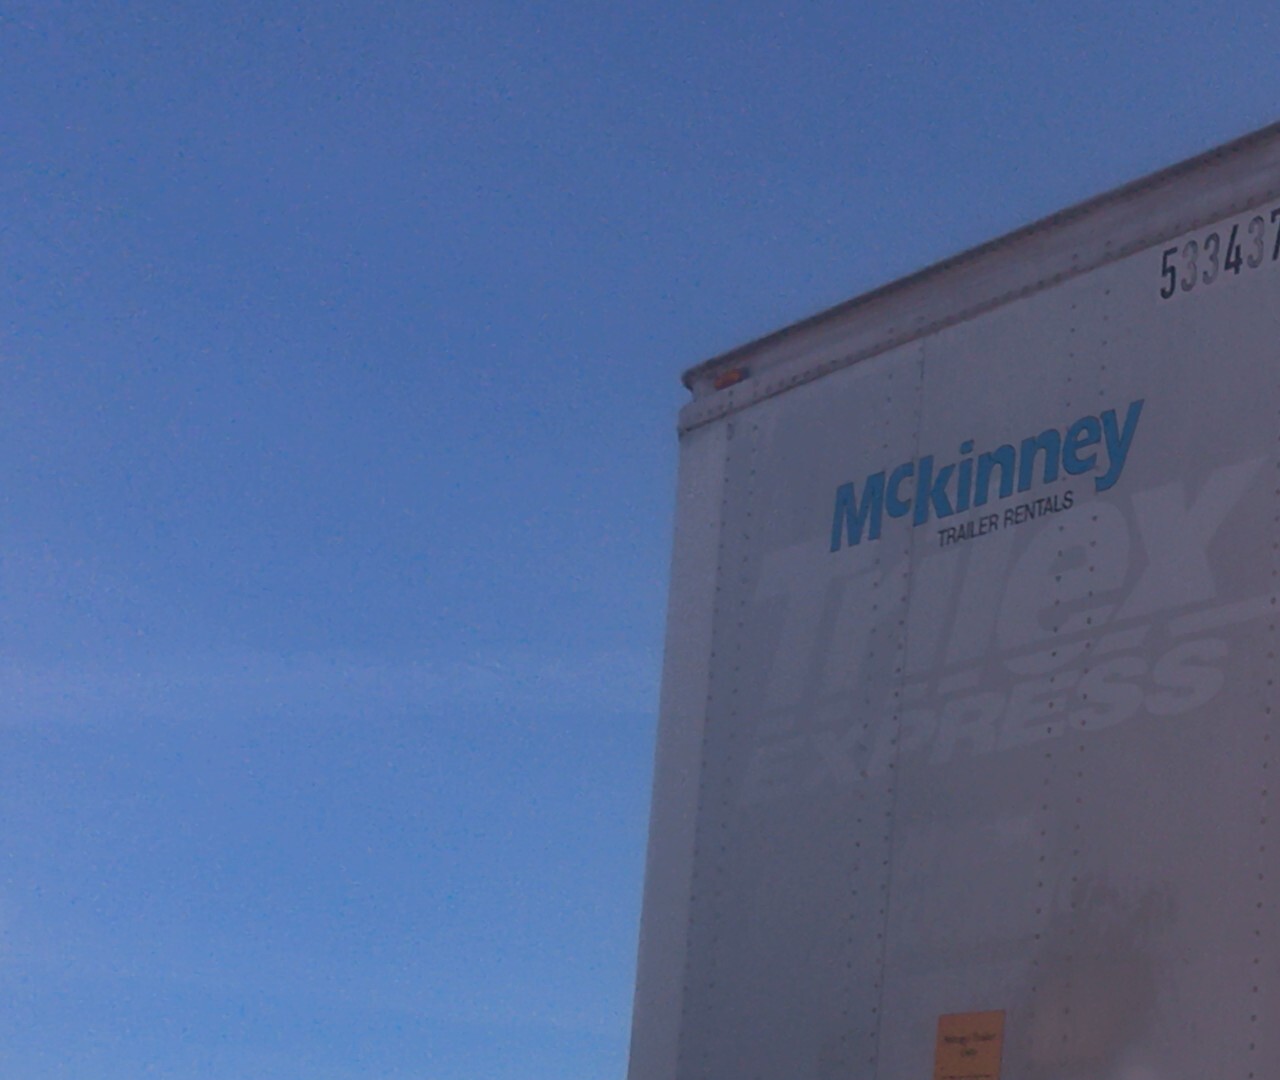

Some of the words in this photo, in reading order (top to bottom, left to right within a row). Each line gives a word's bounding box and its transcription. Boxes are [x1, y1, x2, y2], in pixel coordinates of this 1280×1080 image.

[937, 514, 998, 547] TRAILER
[1004, 489, 1074, 528] RENTALS
[738, 638, 1230, 808] EXPRESS
